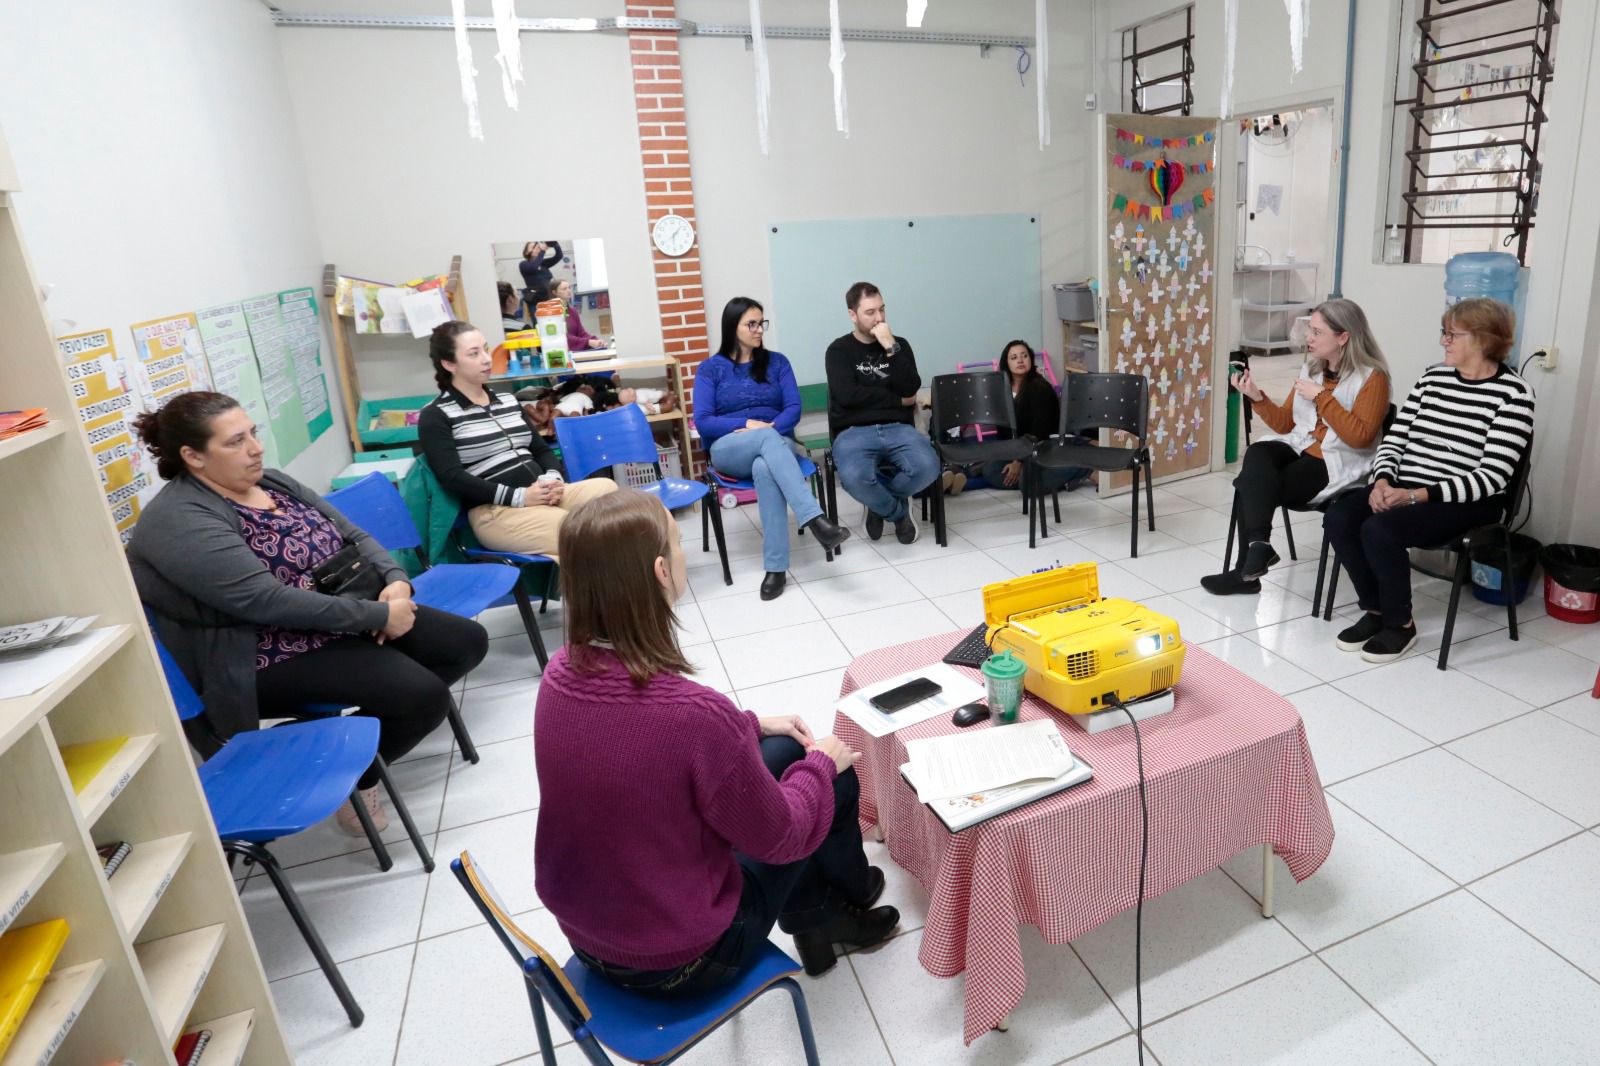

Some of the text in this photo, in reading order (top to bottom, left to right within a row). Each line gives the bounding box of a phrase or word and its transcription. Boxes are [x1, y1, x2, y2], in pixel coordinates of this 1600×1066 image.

[83, 333, 105, 350] FAZER
[81, 360, 103, 376] SEUS
[150, 370, 186, 392] BRINQUEDOS
[86, 394, 132, 419] BRINQUEDOS
[88, 420, 126, 444] DESENHAR
[97, 444, 128, 466] SUA VEZ
[8, 890, 31, 917] VITOR
[51, 1010, 77, 1050] HELENA
